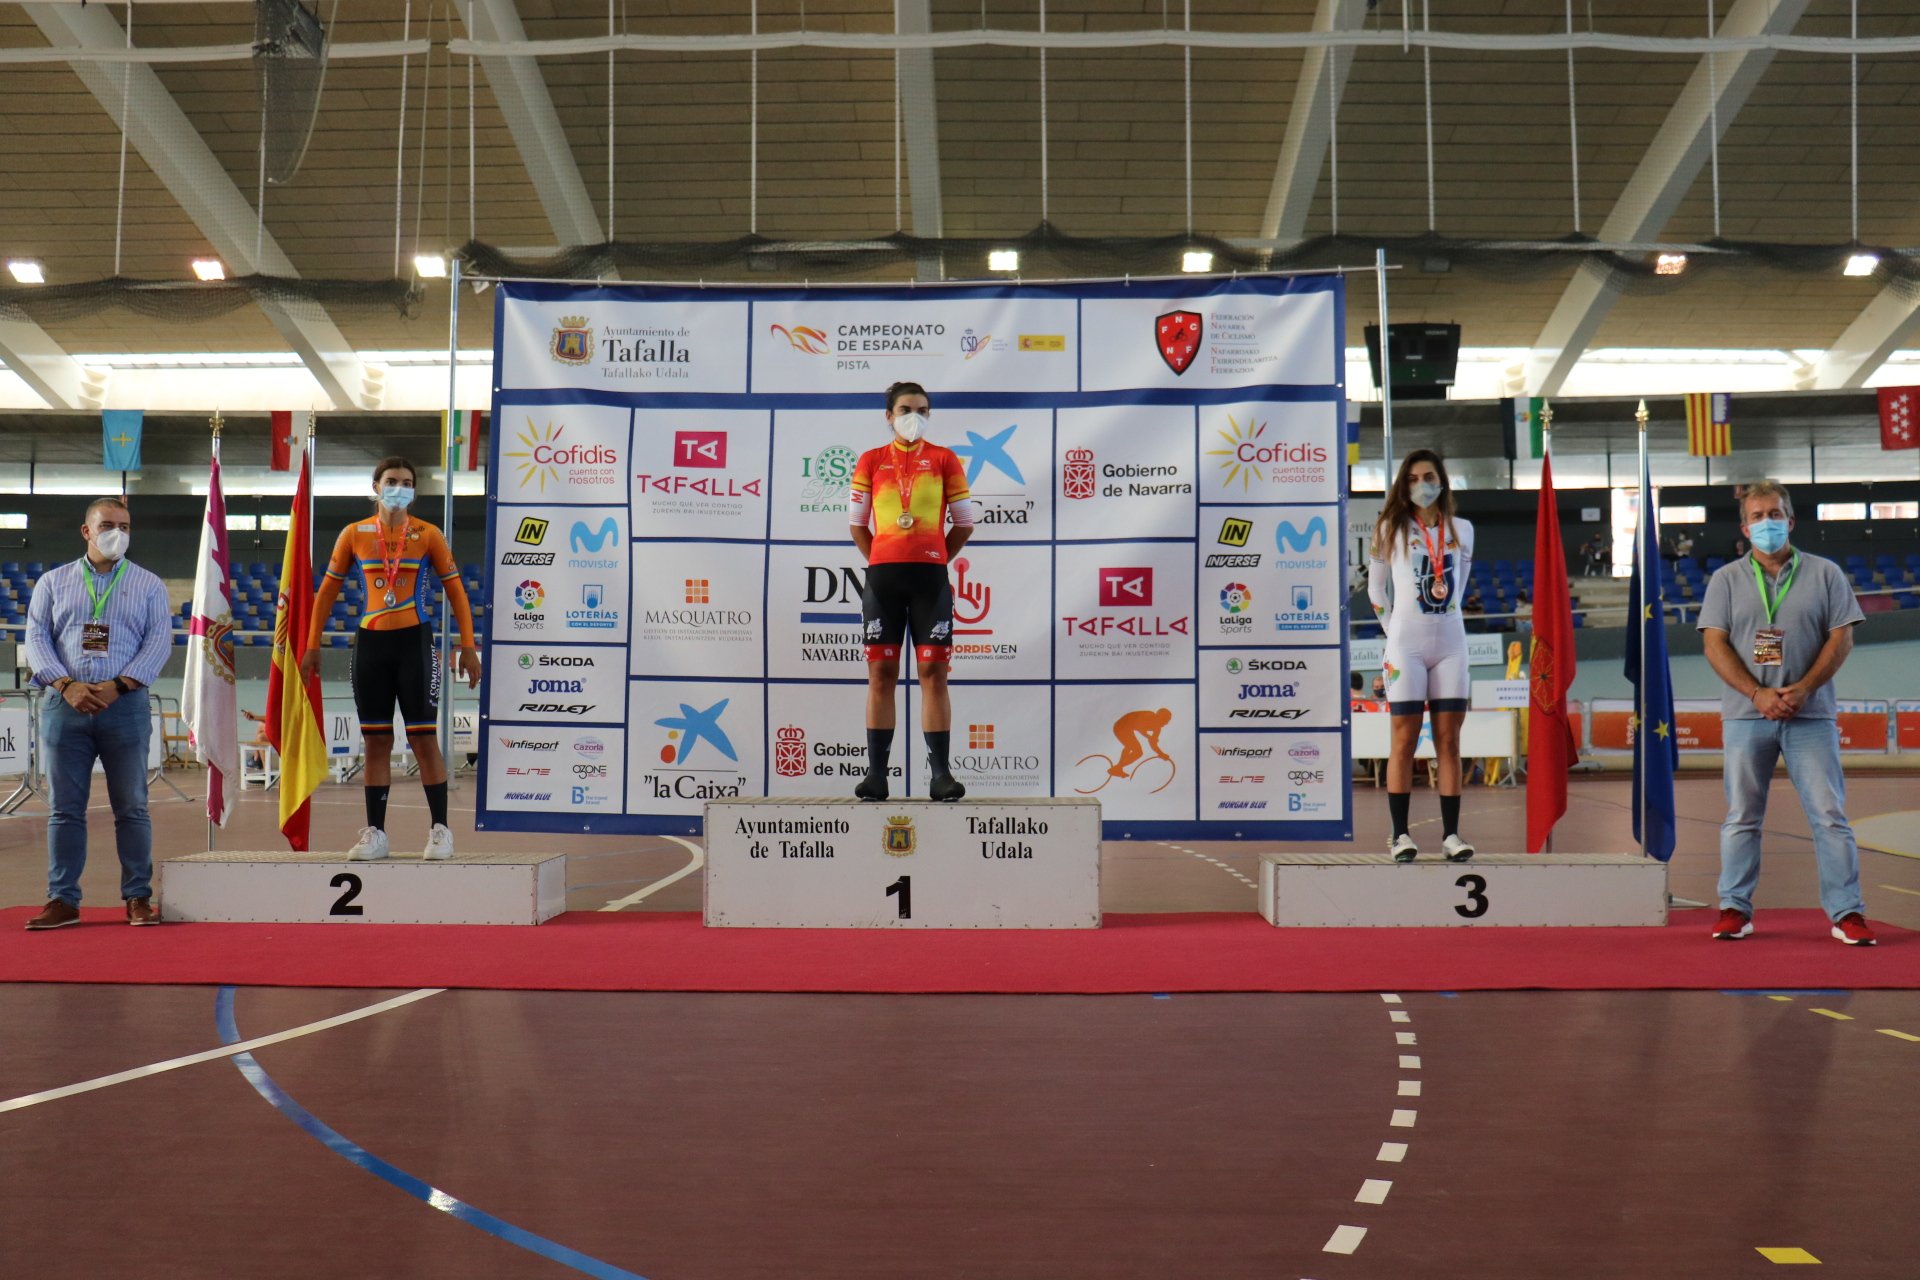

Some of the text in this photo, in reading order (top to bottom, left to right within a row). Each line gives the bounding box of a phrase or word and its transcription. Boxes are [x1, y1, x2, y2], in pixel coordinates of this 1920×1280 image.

[603, 326, 690, 338] Ayuntamiento de
[838, 324, 945, 336] CAMPEONATO
[838, 337, 923, 351] DE ESPAÑA
[961, 336, 978, 352] CSD
[602, 339, 690, 363] Tafalla
[837, 360, 870, 370] PISTA
[601, 367, 689, 378] Tafallako Udala
[534, 444, 617, 464] Cofidis
[1238, 442, 1328, 462] Cofidis
[569, 468, 614, 476] cuenta con
[1102, 464, 1177, 478] Gobierno
[1272, 466, 1325, 474] cuenta con
[568, 476, 615, 484] nosotros
[1272, 474, 1325, 484] nosotros
[637, 475, 761, 497] TAFALLA
[1102, 483, 1192, 497] de Navarra
[800, 504, 847, 512] BEARI
[521, 524, 544, 540] IN
[1224, 524, 1247, 540] IN
[501, 553, 556, 566] INVERSE
[568, 560, 619, 568] movistar
[1205, 554, 1262, 568] INVERSE
[1275, 560, 1328, 568] movistar
[803, 567, 868, 603] DN
[514, 612, 545, 622] LaLiga
[566, 610, 618, 619] LOTERÍAS
[645, 610, 752, 627] MASQUATRO
[1275, 611, 1330, 621] LOTERÍAS
[514, 621, 544, 631] Sports
[1062, 616, 1188, 636] TAFALLA
[1220, 616, 1252, 626] LaLiga
[1220, 624, 1252, 635] Sports
[802, 633, 848, 644] DIARIO
[952, 644, 1017, 654] ORDISVEN
[539, 654, 594, 666] ŠKODA
[1248, 659, 1308, 670] ŠKODA
[528, 679, 584, 694] Joma
[1238, 684, 1297, 700] Joma
[518, 704, 597, 715] RIDLEY
[1229, 710, 1311, 720] RIDLEY
[510, 740, 560, 751] infisport
[574, 744, 604, 752] Cazorla
[813, 742, 868, 757] Gobier
[1221, 746, 1273, 758] infisport
[814, 762, 902, 777] de Navra
[504, 792, 552, 800] MORGAN BLUE
[1218, 800, 1269, 809] MORGAN BLUE
[735, 816, 850, 838] Ayuntamiento
[966, 816, 1048, 834] Tafallako
[750, 840, 834, 858] de Tafalla
[981, 842, 1033, 859] Udala
[329, 872, 364, 916] 2
[886, 875, 912, 919] 1
[1454, 874, 1489, 918] 3
